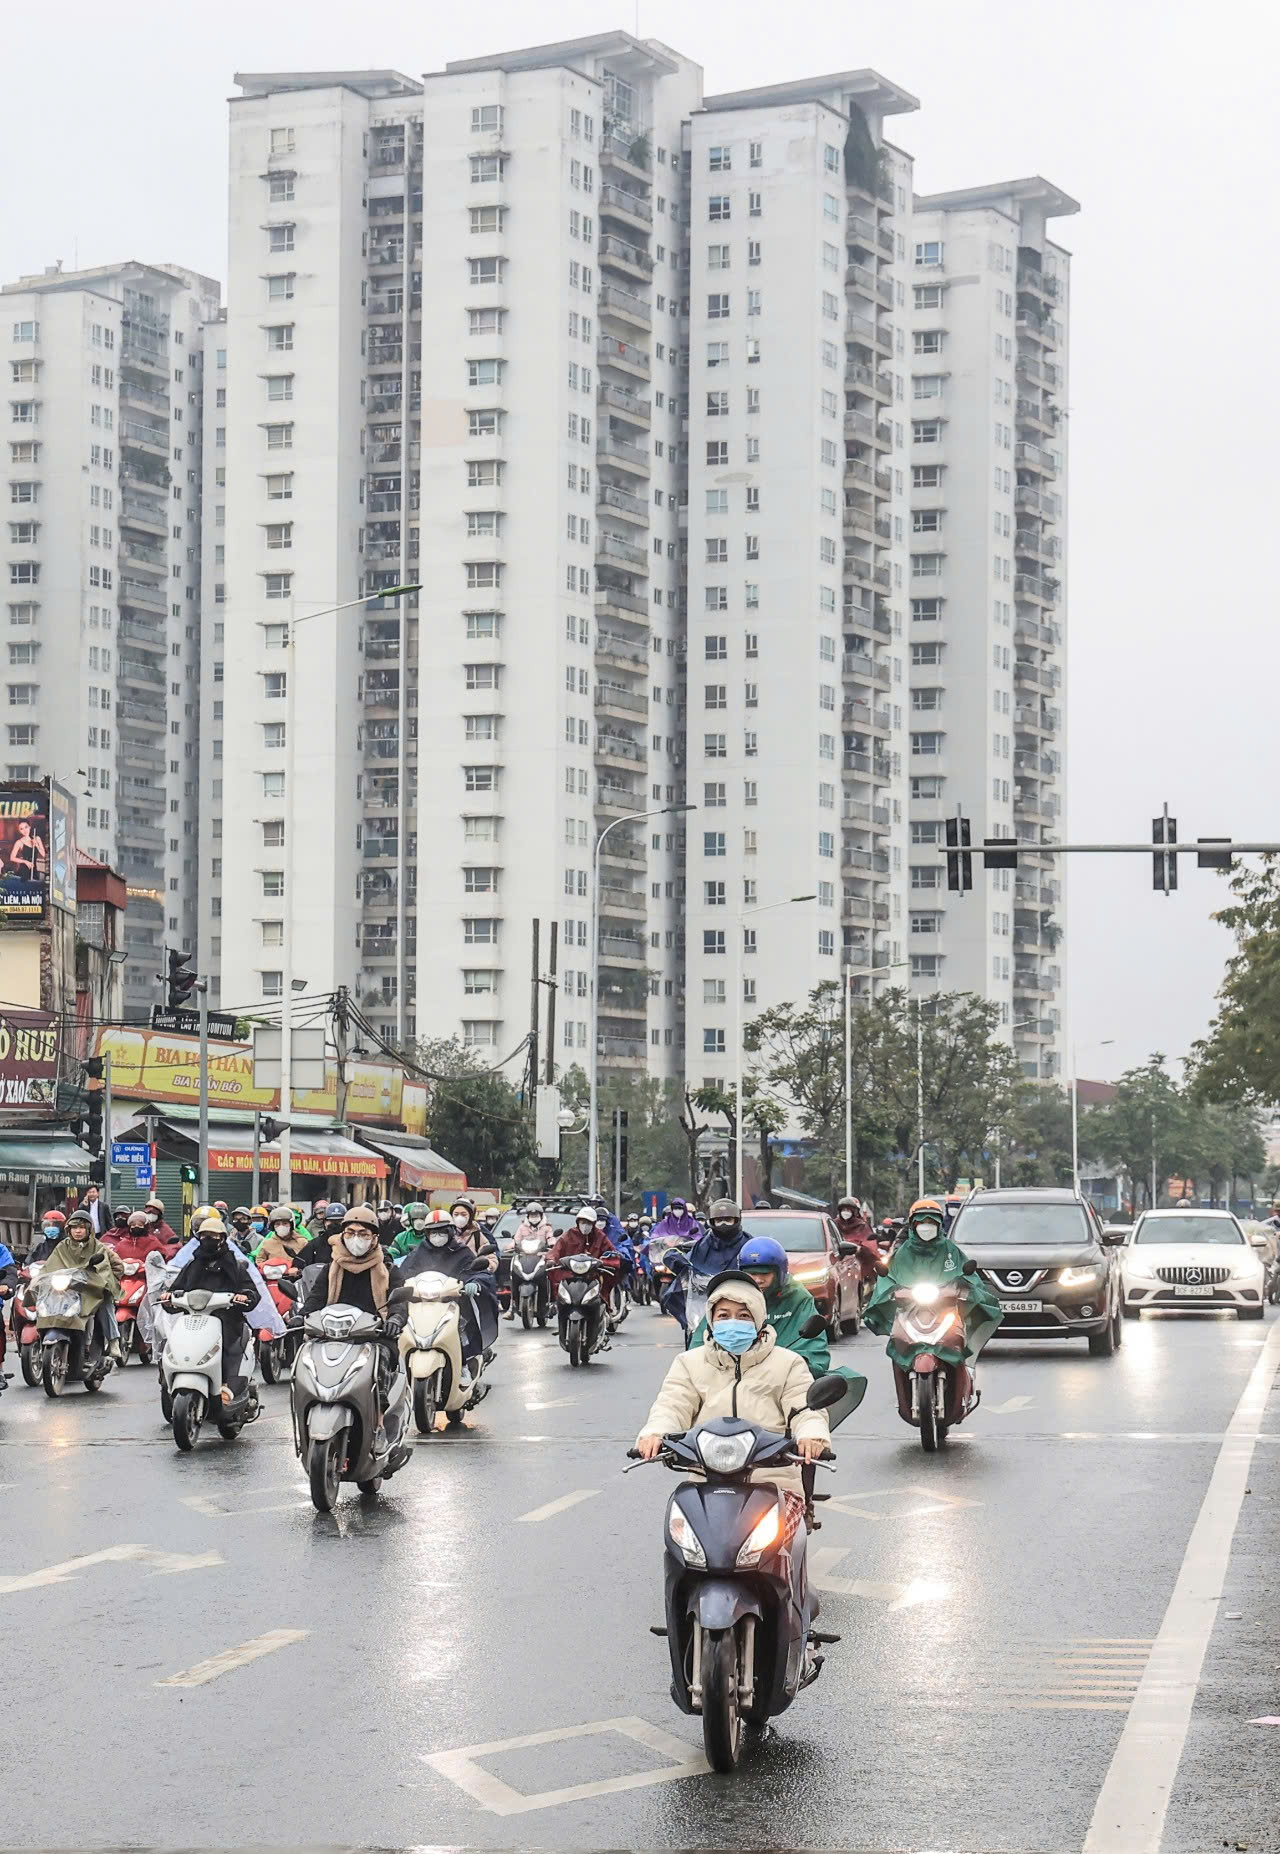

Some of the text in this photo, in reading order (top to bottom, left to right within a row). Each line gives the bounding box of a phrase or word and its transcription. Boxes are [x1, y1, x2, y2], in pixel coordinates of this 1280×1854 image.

[14, 1016, 58, 1062] HUẾ
[155, 1047, 181, 1064] BIA
[172, 1075, 191, 1087] BIA
[220, 1079, 242, 1093] BÉO
[217, 1154, 234, 1168] CÁC
[8, 1172, 30, 1184] Rang
